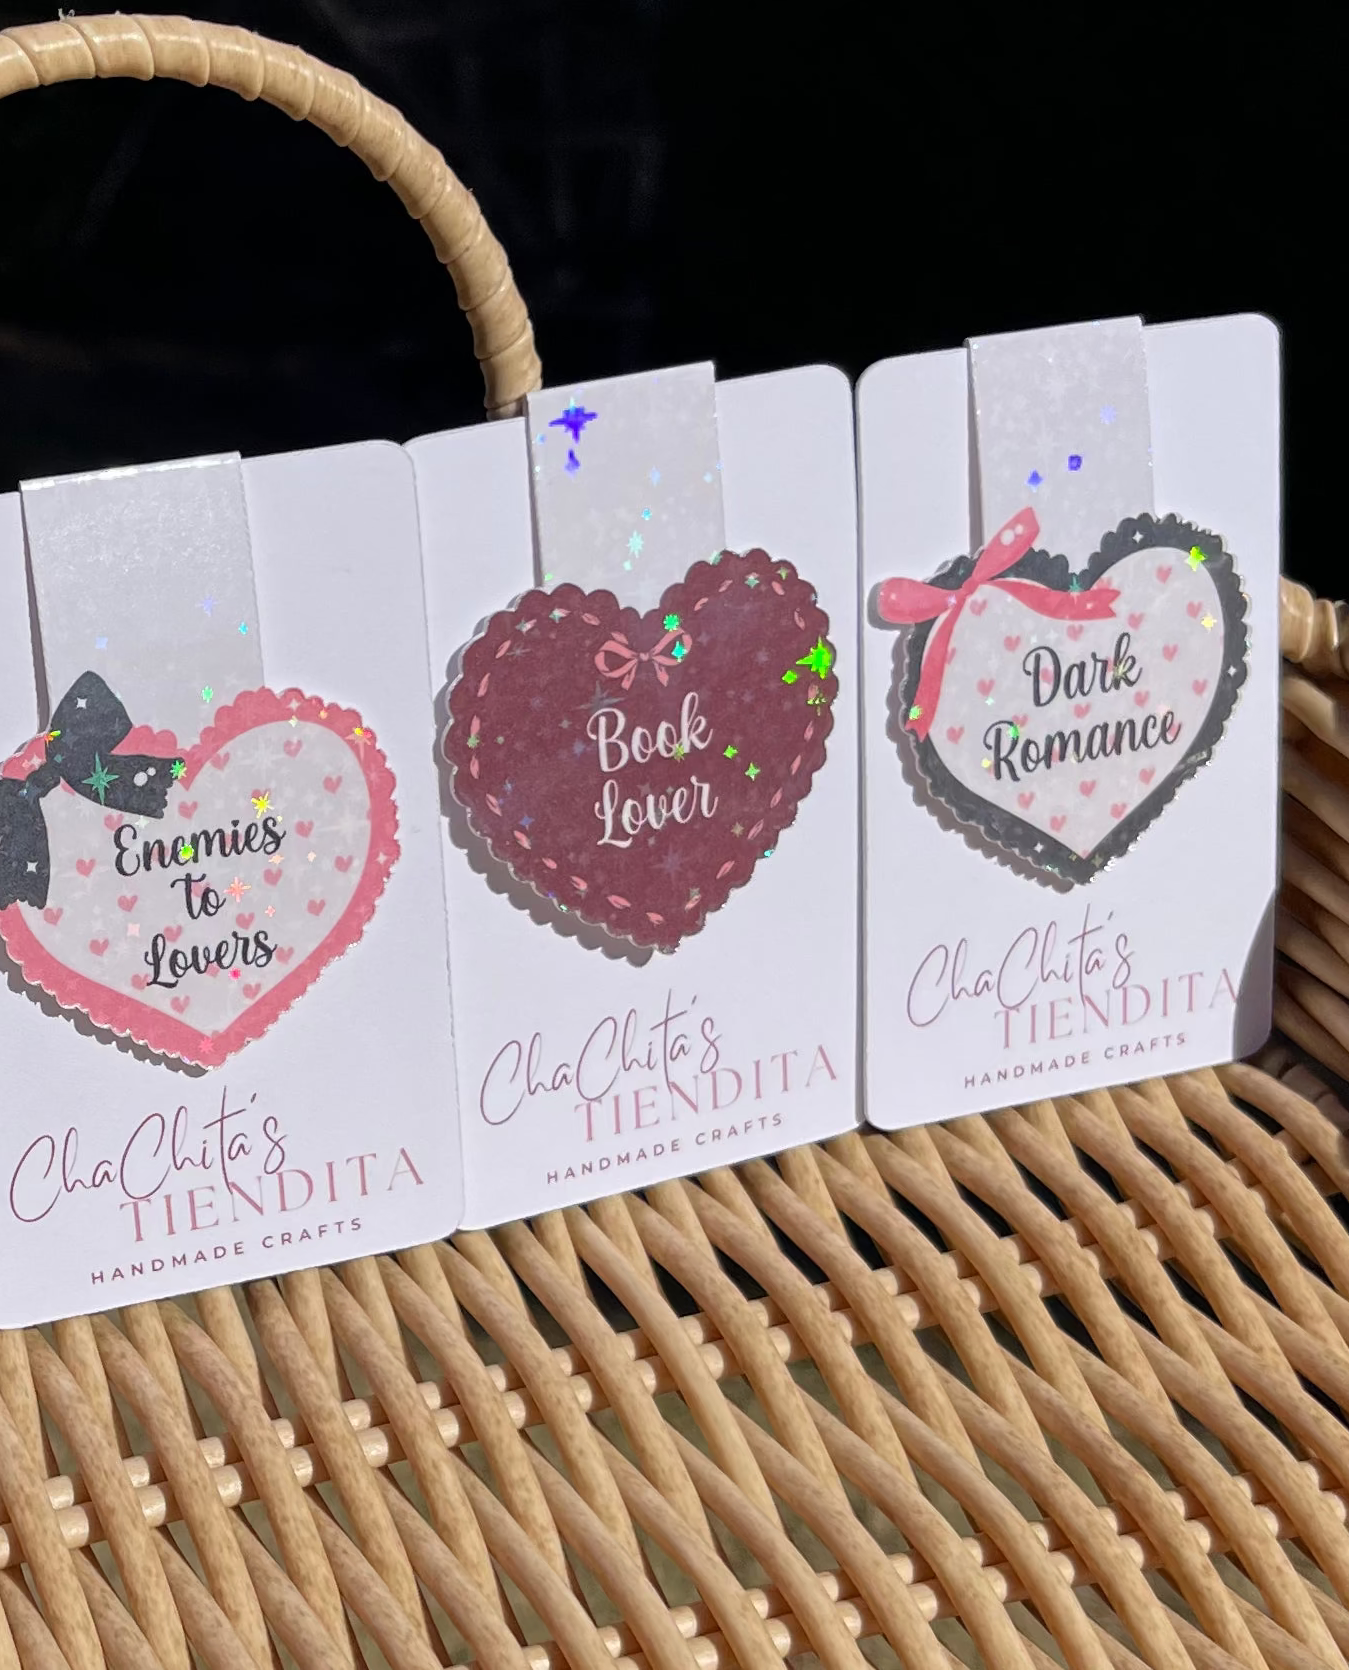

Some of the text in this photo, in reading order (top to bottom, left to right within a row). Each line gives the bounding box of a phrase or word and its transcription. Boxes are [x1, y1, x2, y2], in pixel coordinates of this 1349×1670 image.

[1022, 632, 1143, 707] Dark
[586, 692, 714, 772] Book
[983, 711, 1182, 782] Romance
[113, 817, 286, 876] Enemies
[594, 775, 719, 848] Lover
[144, 930, 278, 988] Lovers
[907, 903, 1135, 1027] ChaChita's
[994, 968, 1238, 1050] TIENDITA
[480, 988, 722, 1125] ChaChita's
[574, 1043, 838, 1142] TIENDITA
[964, 1032, 1187, 1089] HANDMADE CRAFTS
[9, 1085, 287, 1222] ChaChita's
[546, 1112, 783, 1185] HANDMADE CRAFTS
[119, 1147, 424, 1243] TIENDITA
[90, 1217, 363, 1285] HANDMADE CRAFTS
